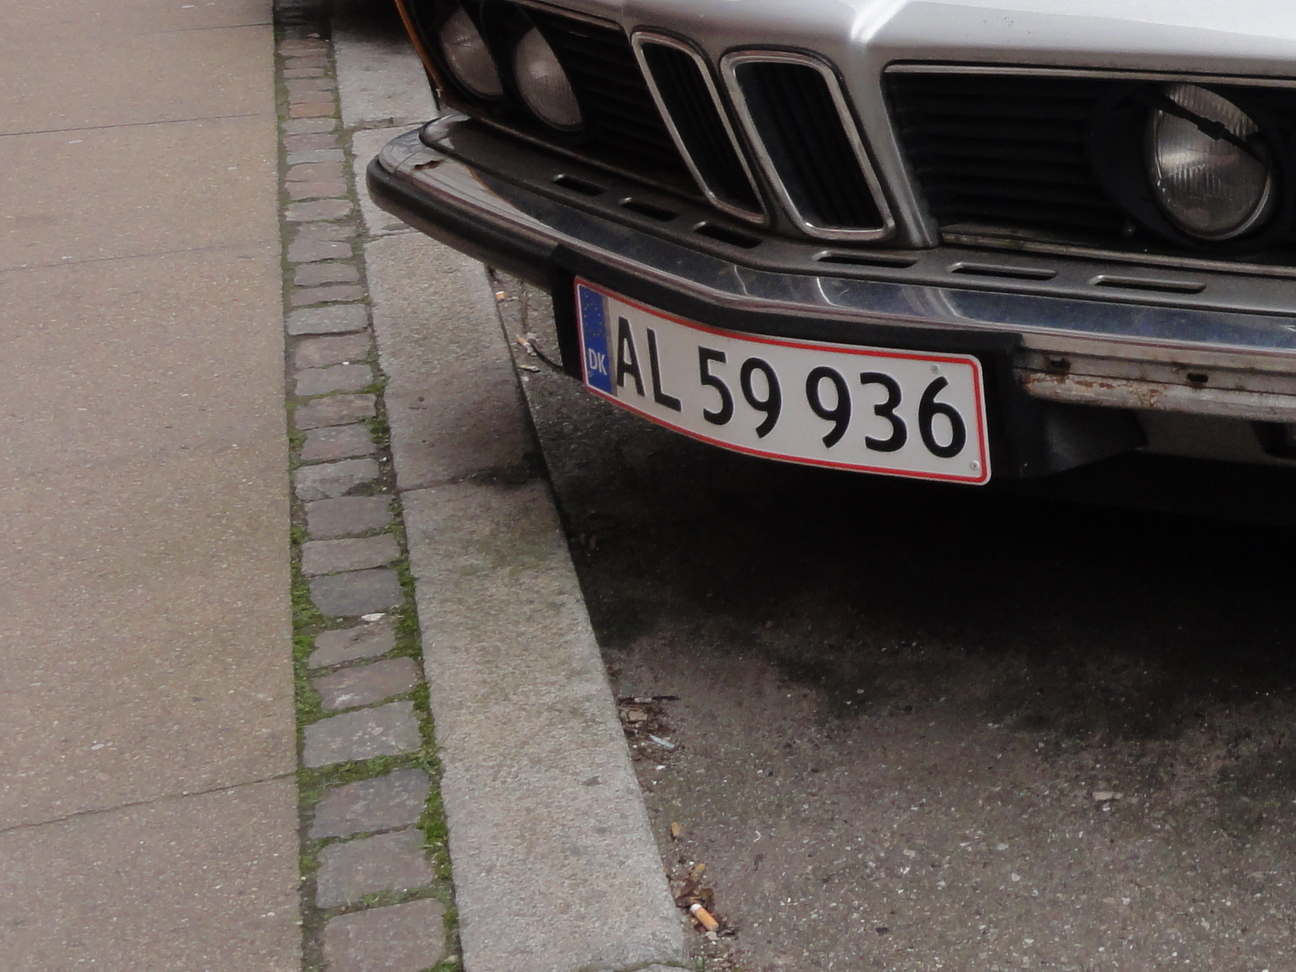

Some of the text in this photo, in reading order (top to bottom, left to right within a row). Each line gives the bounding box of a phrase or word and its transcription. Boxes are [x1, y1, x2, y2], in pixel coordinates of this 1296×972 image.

[588, 348, 607, 375] DK
[615, 315, 967, 459] AL 59 936
